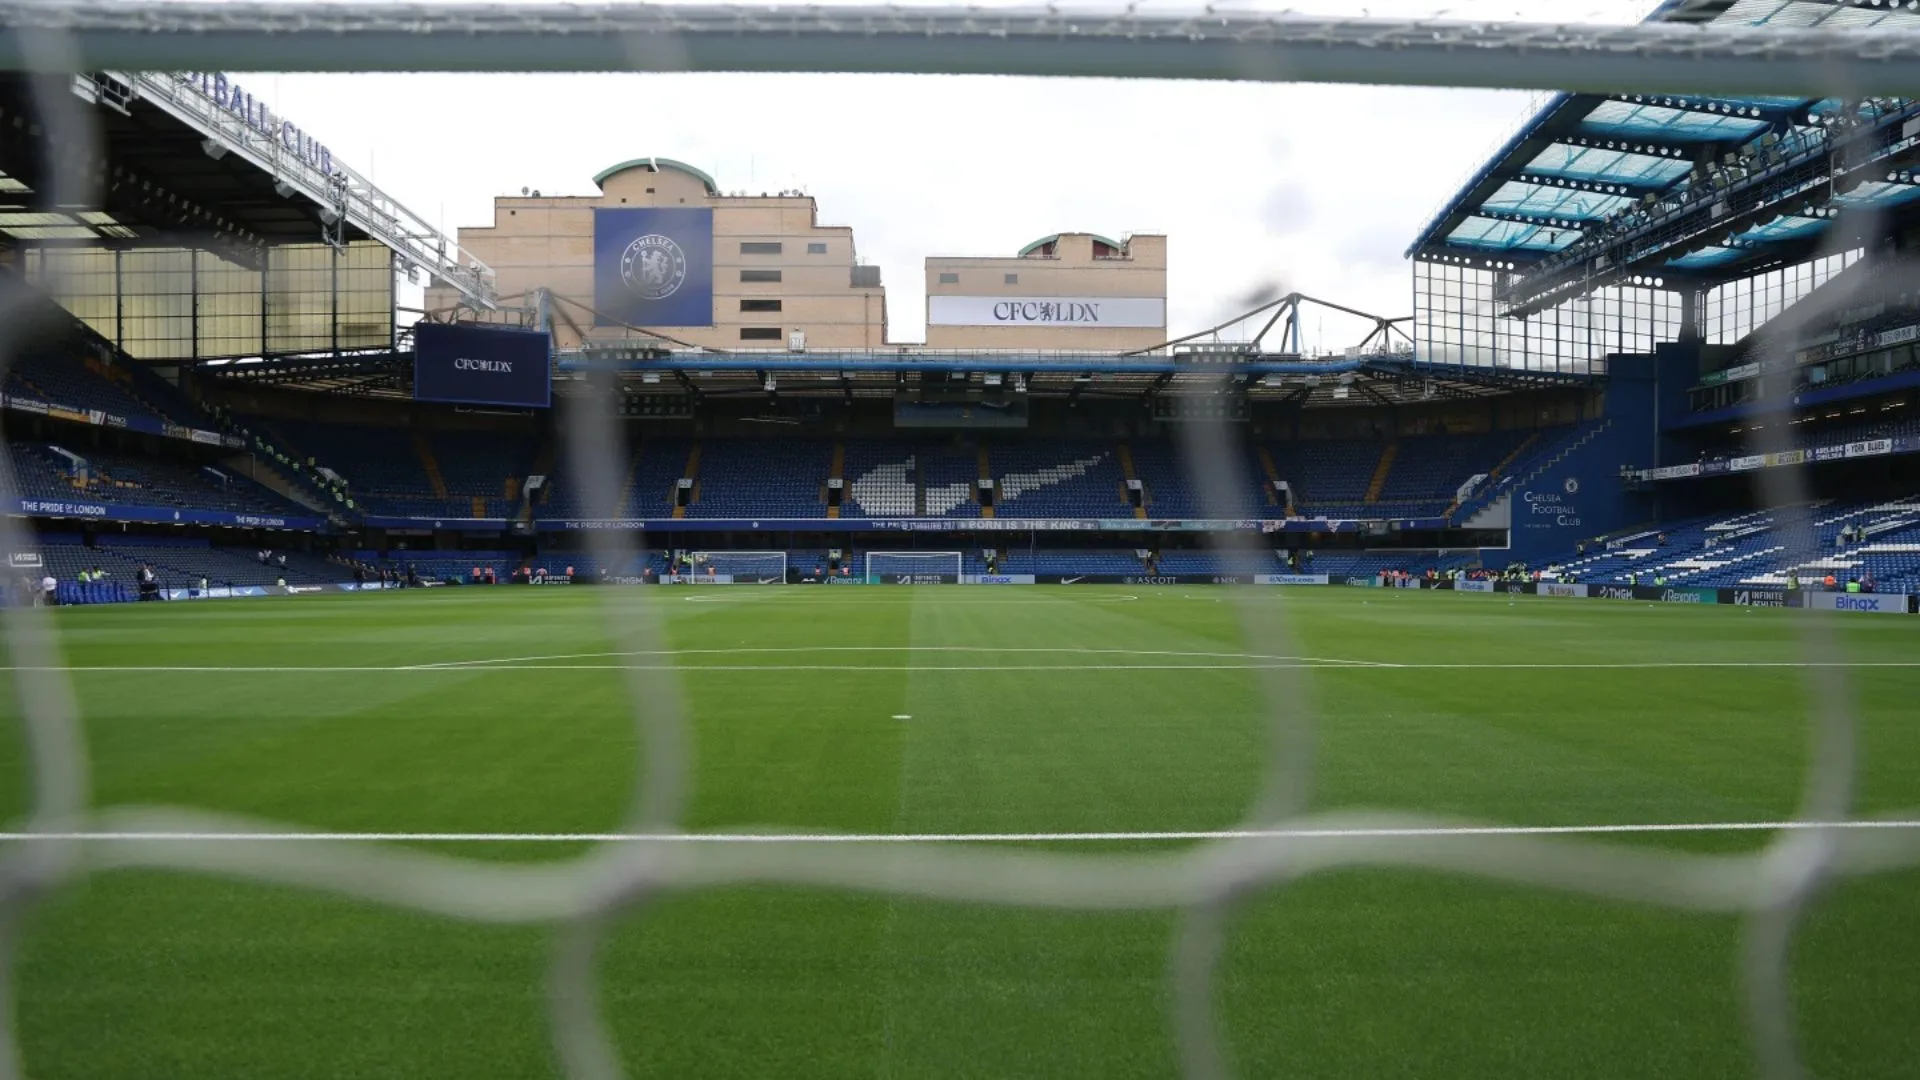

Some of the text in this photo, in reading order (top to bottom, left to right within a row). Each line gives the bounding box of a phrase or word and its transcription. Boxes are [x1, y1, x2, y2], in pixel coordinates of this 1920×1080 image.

[190, 71, 332, 175] TBALL CLUB
[632, 237, 673, 251] CHELSEA
[993, 302, 1100, 323] CFC LDN
[454, 358, 513, 373] CFC LDN
[1524, 491, 1561, 502] CHELSEA
[21, 500, 38, 511] THE
[39, 502, 64, 513] PRIDE
[74, 505, 106, 515] LONDON
[1531, 503, 1576, 514] FOOTBALL
[1006, 521, 1017, 530] IS
[1023, 521, 1047, 530] THE
[1050, 521, 1080, 530] KING
[1556, 515, 1581, 526] CLUB
[1137, 576, 1177, 584] ASCOTT
[1609, 588, 1633, 599] TMGM
[1667, 589, 1701, 603] Rexona
[1752, 591, 1783, 601] INFINITE
